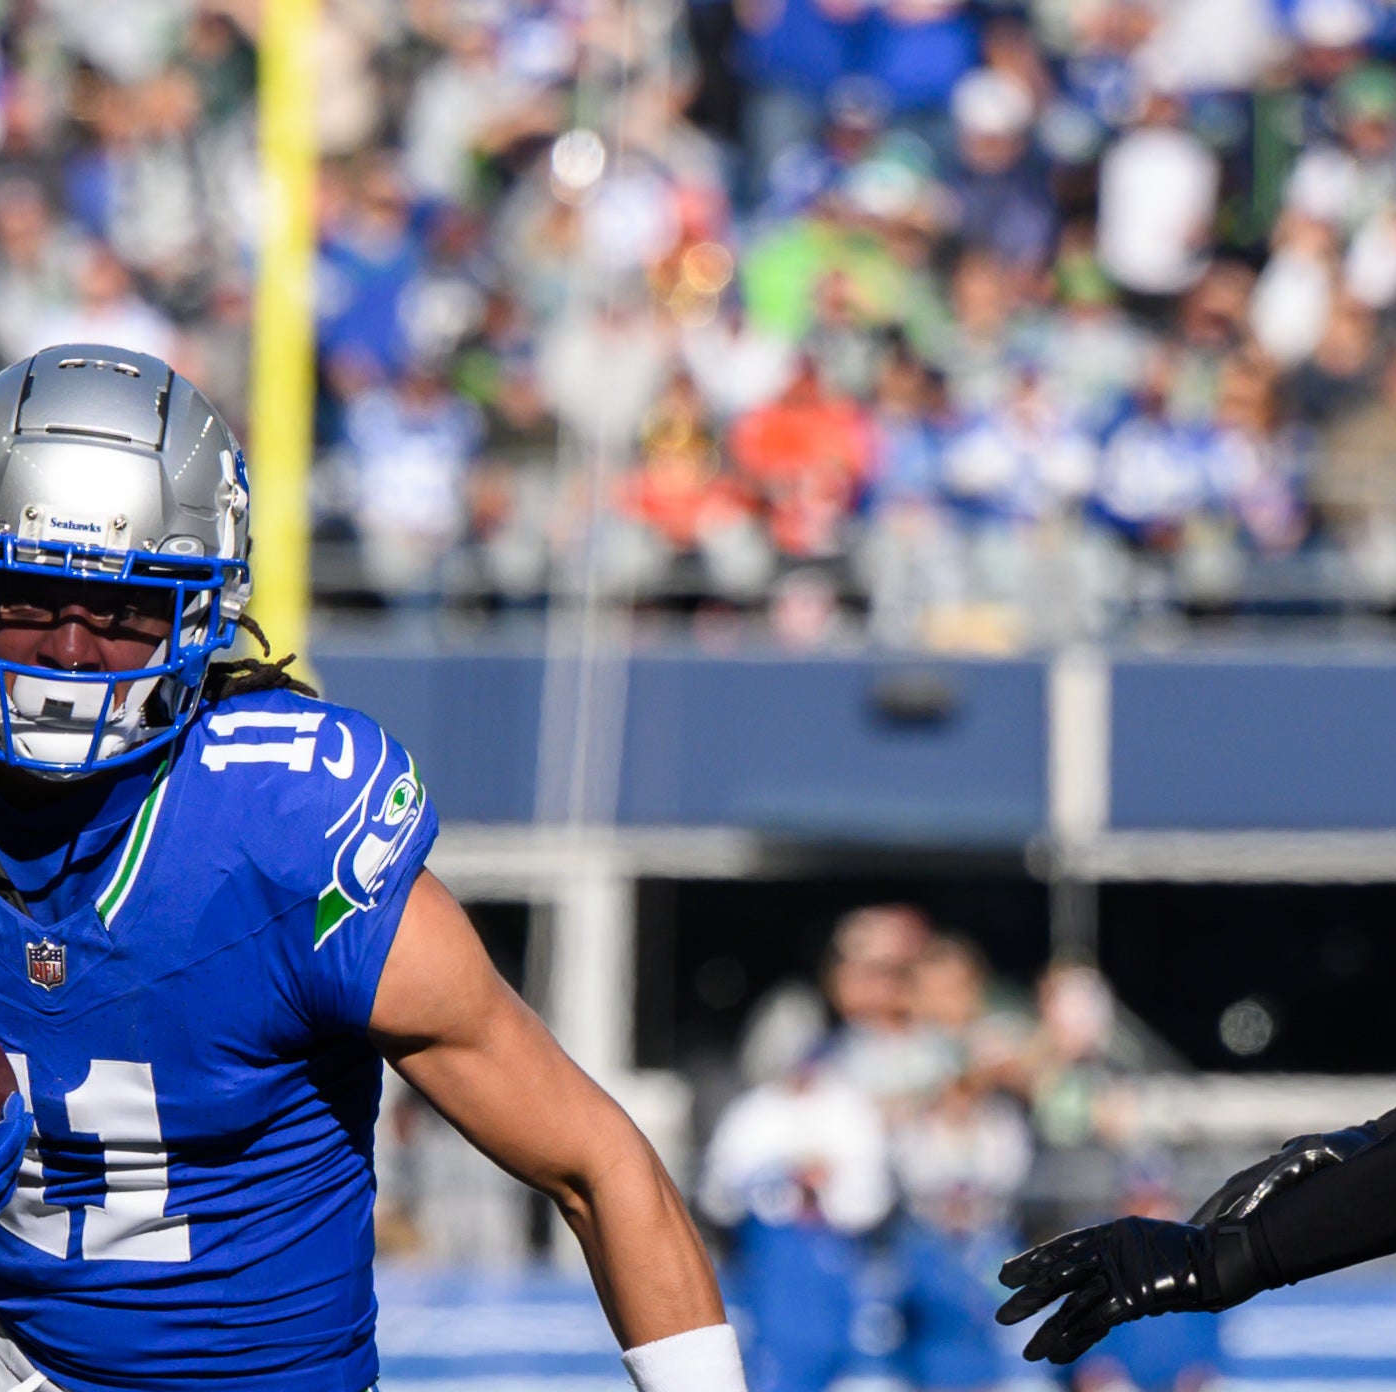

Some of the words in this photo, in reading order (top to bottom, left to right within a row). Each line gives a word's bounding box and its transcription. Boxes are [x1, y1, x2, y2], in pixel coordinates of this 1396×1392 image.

[49, 517, 102, 533] Seahawks
[200, 711, 326, 772] 11
[31, 960, 62, 982] NFL
